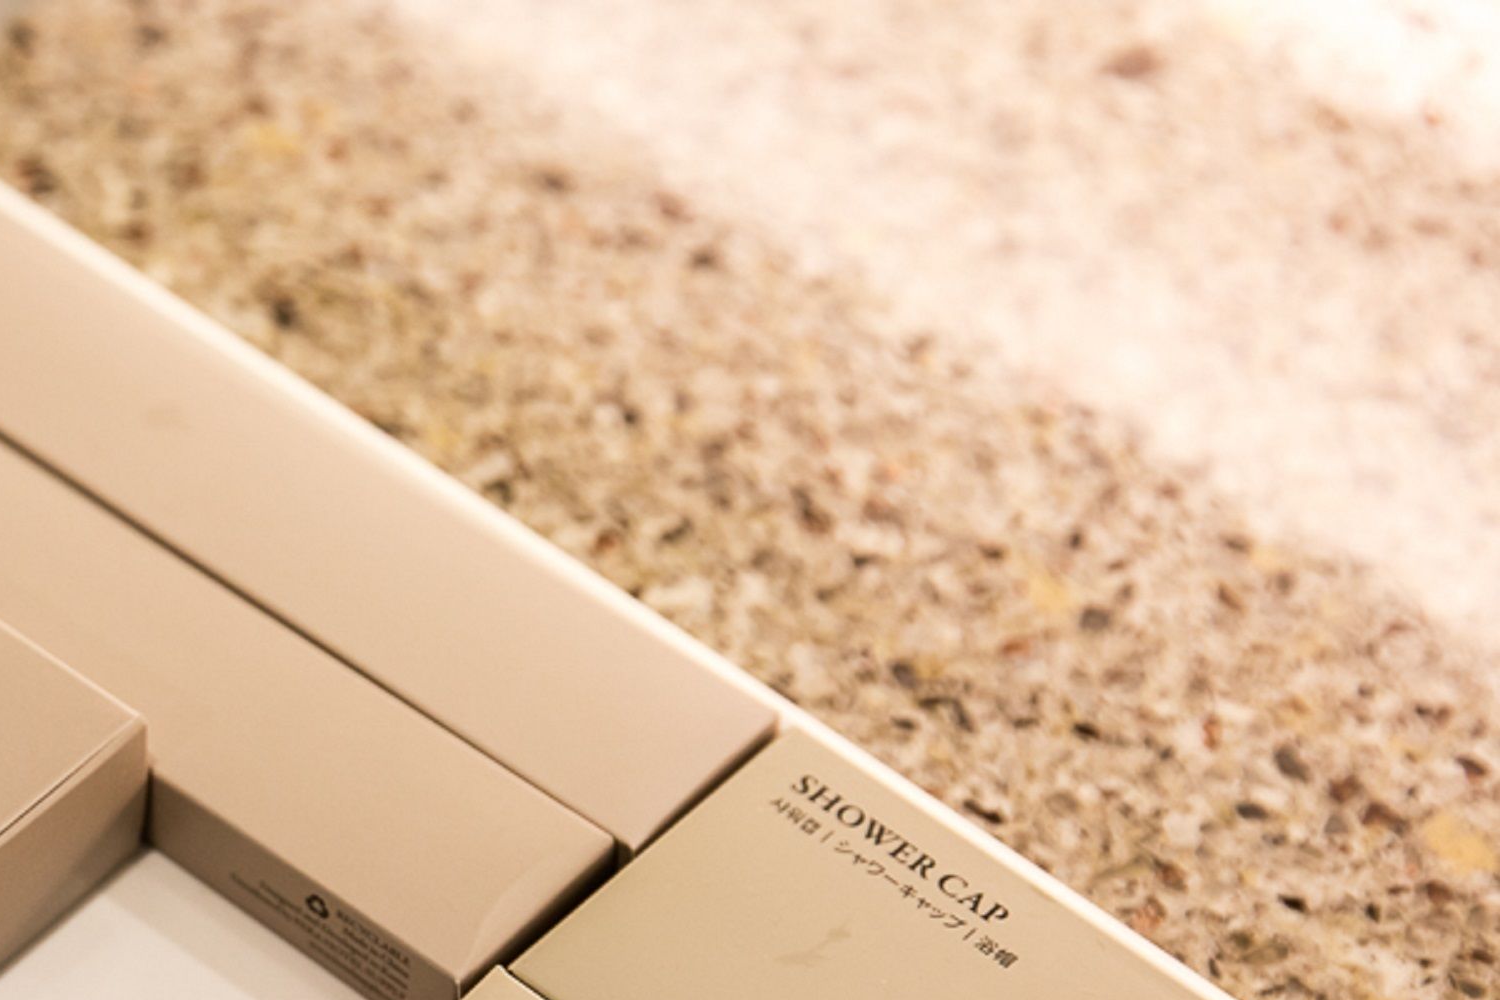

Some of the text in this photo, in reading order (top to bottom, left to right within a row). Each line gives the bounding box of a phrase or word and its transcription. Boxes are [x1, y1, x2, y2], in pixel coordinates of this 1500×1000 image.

[791, 774, 1010, 925] SHOWER CAP
[834, 839, 967, 930] シャワーキャップ
